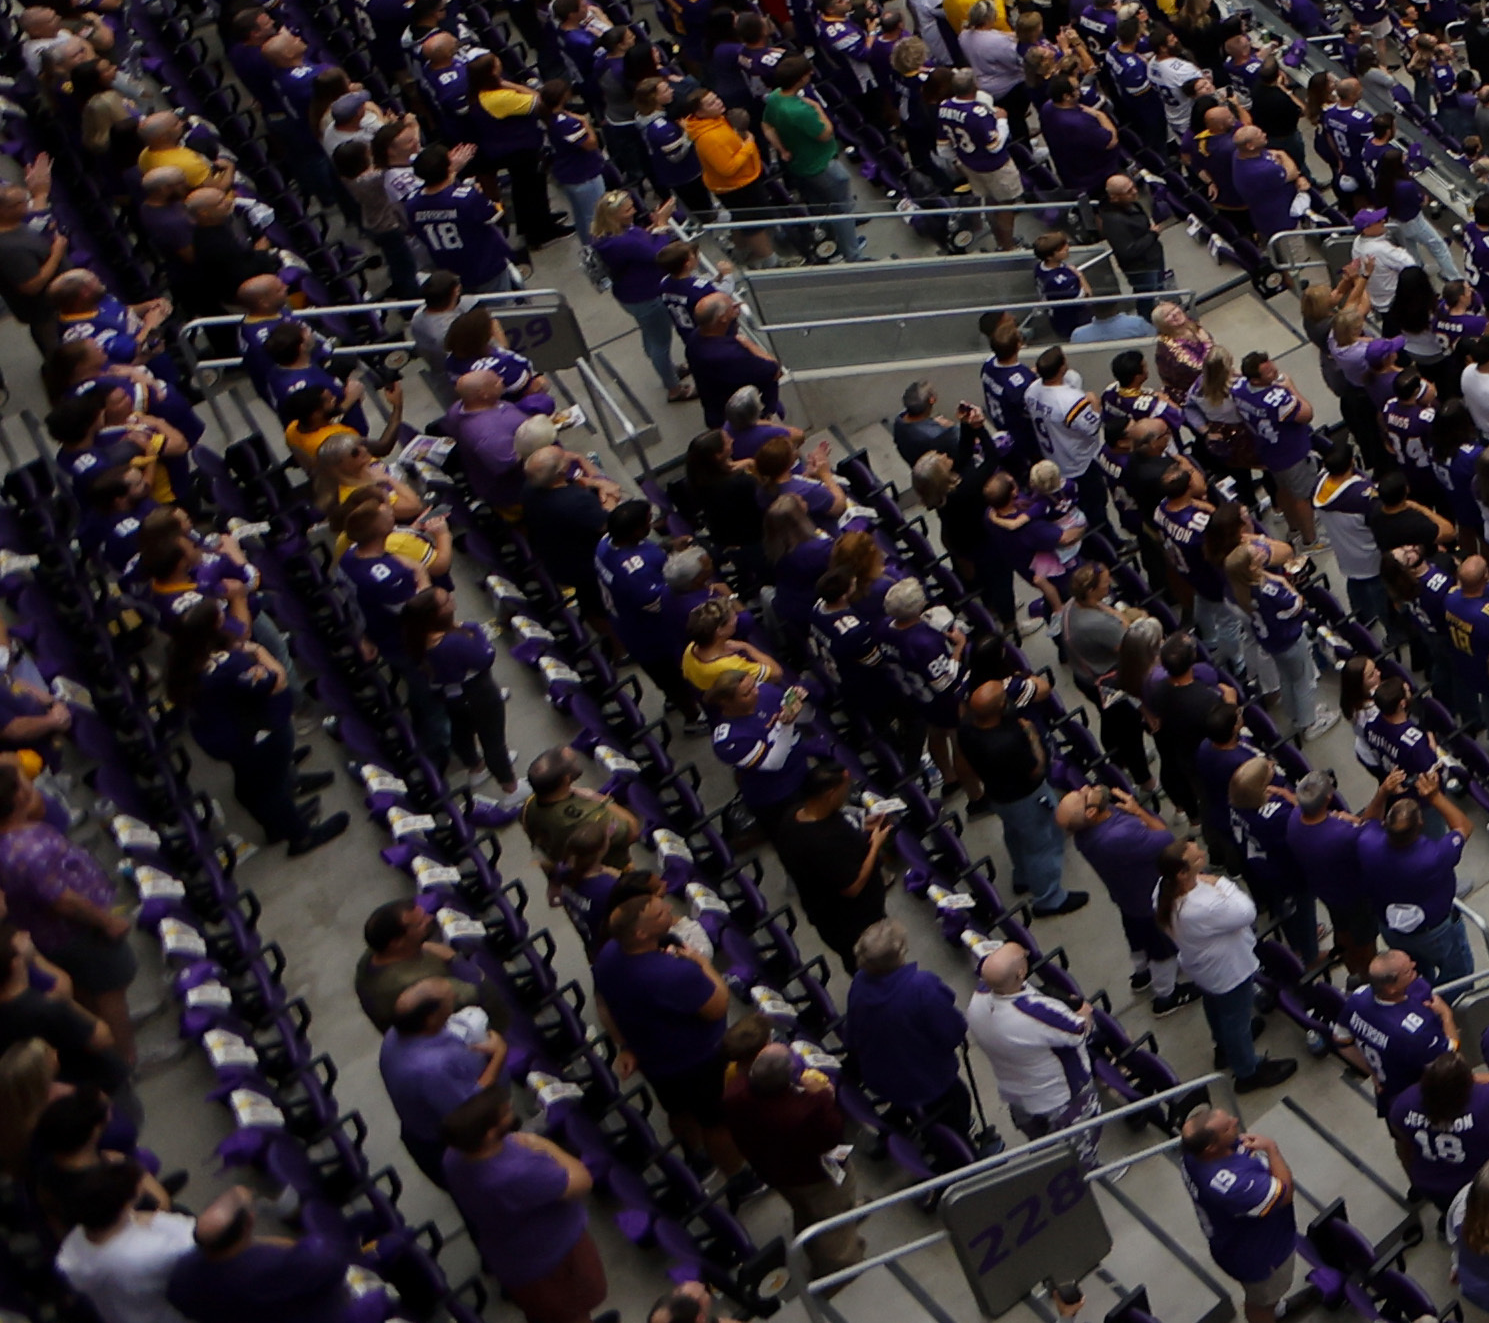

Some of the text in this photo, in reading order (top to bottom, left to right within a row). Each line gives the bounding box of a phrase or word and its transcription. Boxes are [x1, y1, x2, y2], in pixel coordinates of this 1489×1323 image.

[421, 220, 464, 251] 18
[507, 315, 553, 354] 29
[1388, 413, 1410, 430] MOSS
[371, 561, 391, 581] 8
[1426, 572, 1449, 593] 22
[1400, 726, 1424, 747] 19
[1413, 1129, 1468, 1165] 18
[1208, 1167, 1238, 1195] 19
[967, 1167, 1087, 1277] 228
